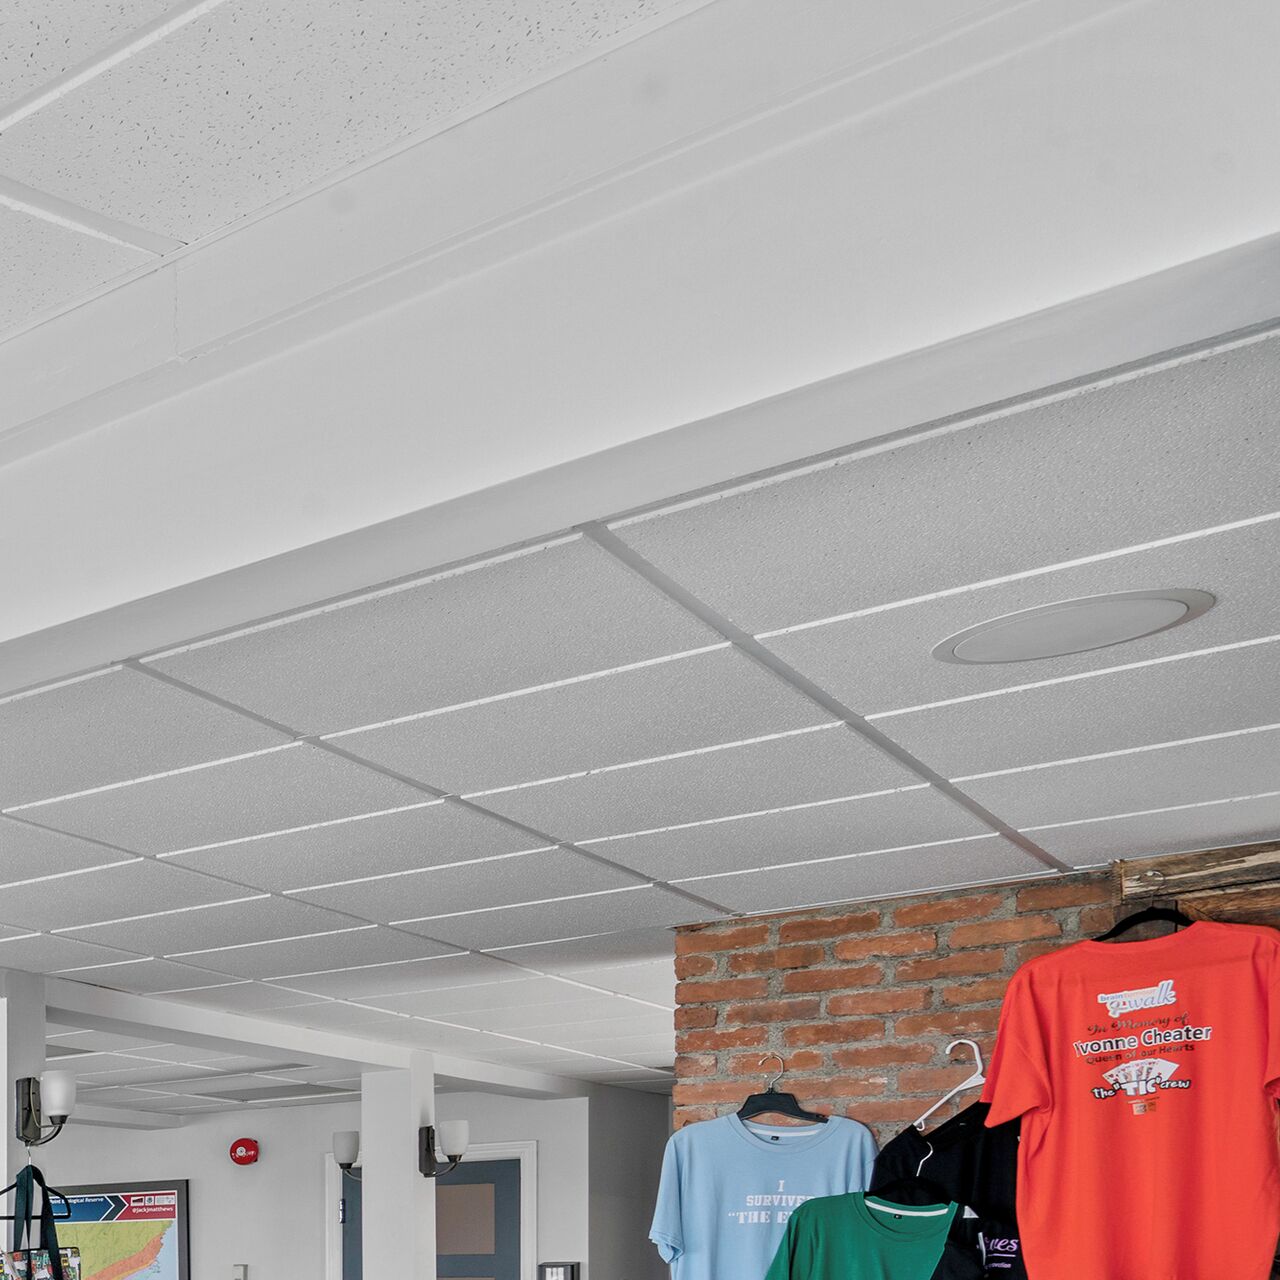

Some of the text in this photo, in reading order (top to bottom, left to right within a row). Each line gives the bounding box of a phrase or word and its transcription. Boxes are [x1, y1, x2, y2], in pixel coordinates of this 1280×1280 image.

[1128, 981, 1176, 1009] walk
[1111, 1015, 1170, 1032] Memory
[1174, 1012, 1190, 1025] of
[1142, 1025, 1212, 1046] Cheater
[1085, 1053, 1122, 1065] Queen
[1141, 1048, 1158, 1057] our
[1159, 1043, 1195, 1054] Hearts
[1092, 1086, 1116, 1099] the
[1160, 1079, 1191, 1090] crew
[778, 1180, 785, 1192] I
[746, 1195, 816, 1207] SURVIVE
